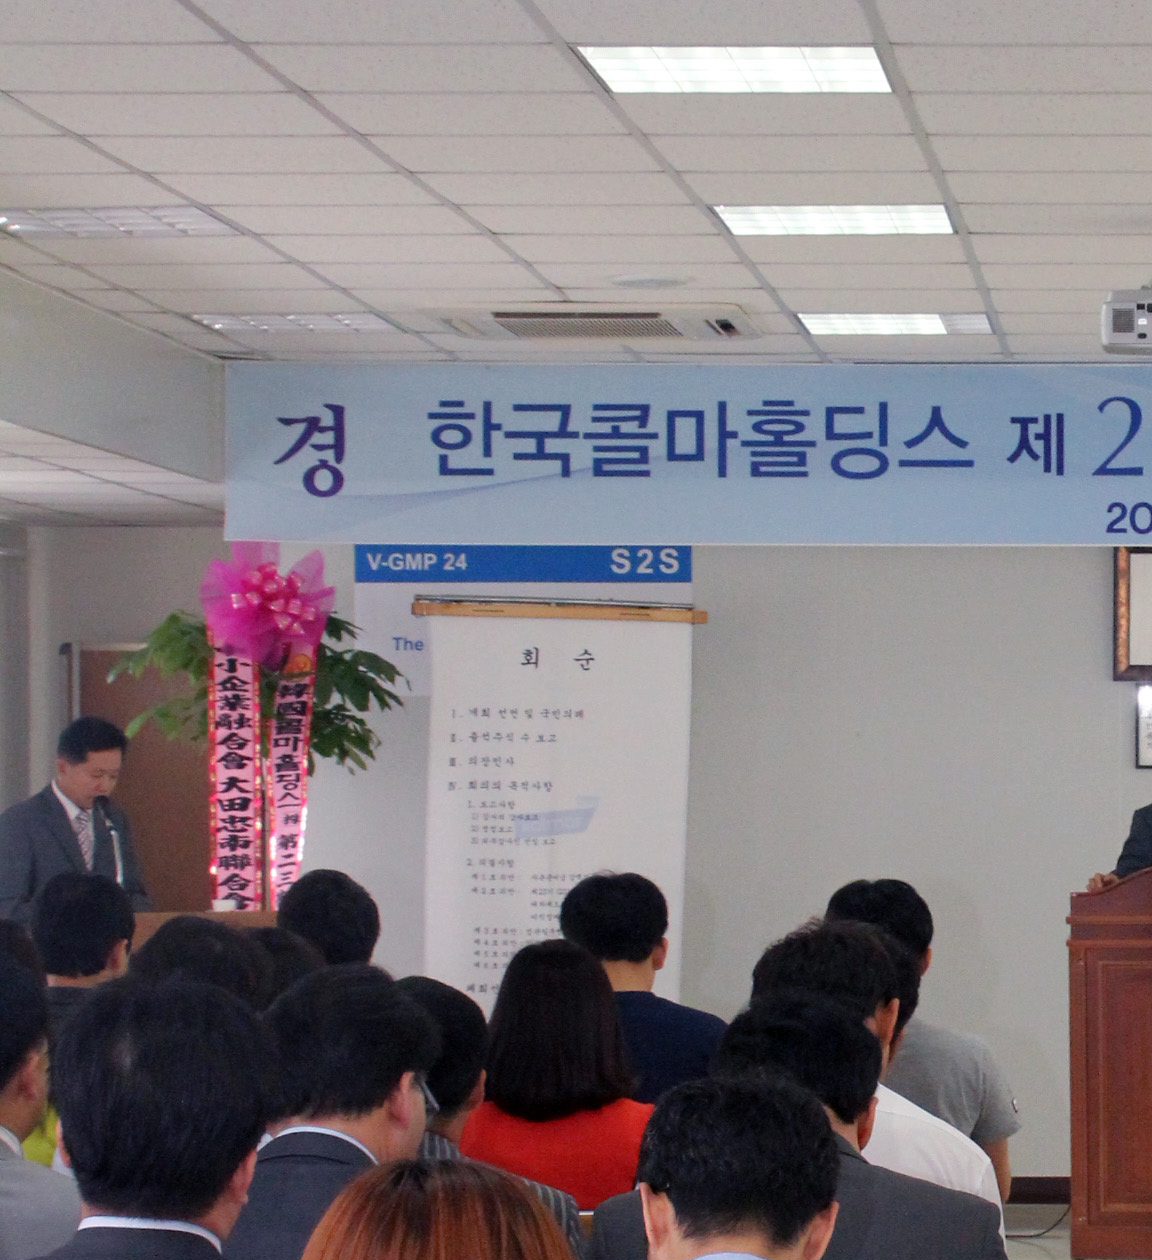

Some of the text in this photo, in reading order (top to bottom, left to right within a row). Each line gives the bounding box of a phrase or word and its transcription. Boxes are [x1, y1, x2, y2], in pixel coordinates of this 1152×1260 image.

[274, 404, 346, 498] 경
[428, 399, 975, 480] 한국콜마홀딩스
[1007, 412, 1065, 477] 제
[366, 553, 468, 571] V-GMP 24
[392, 636, 425, 651] The
